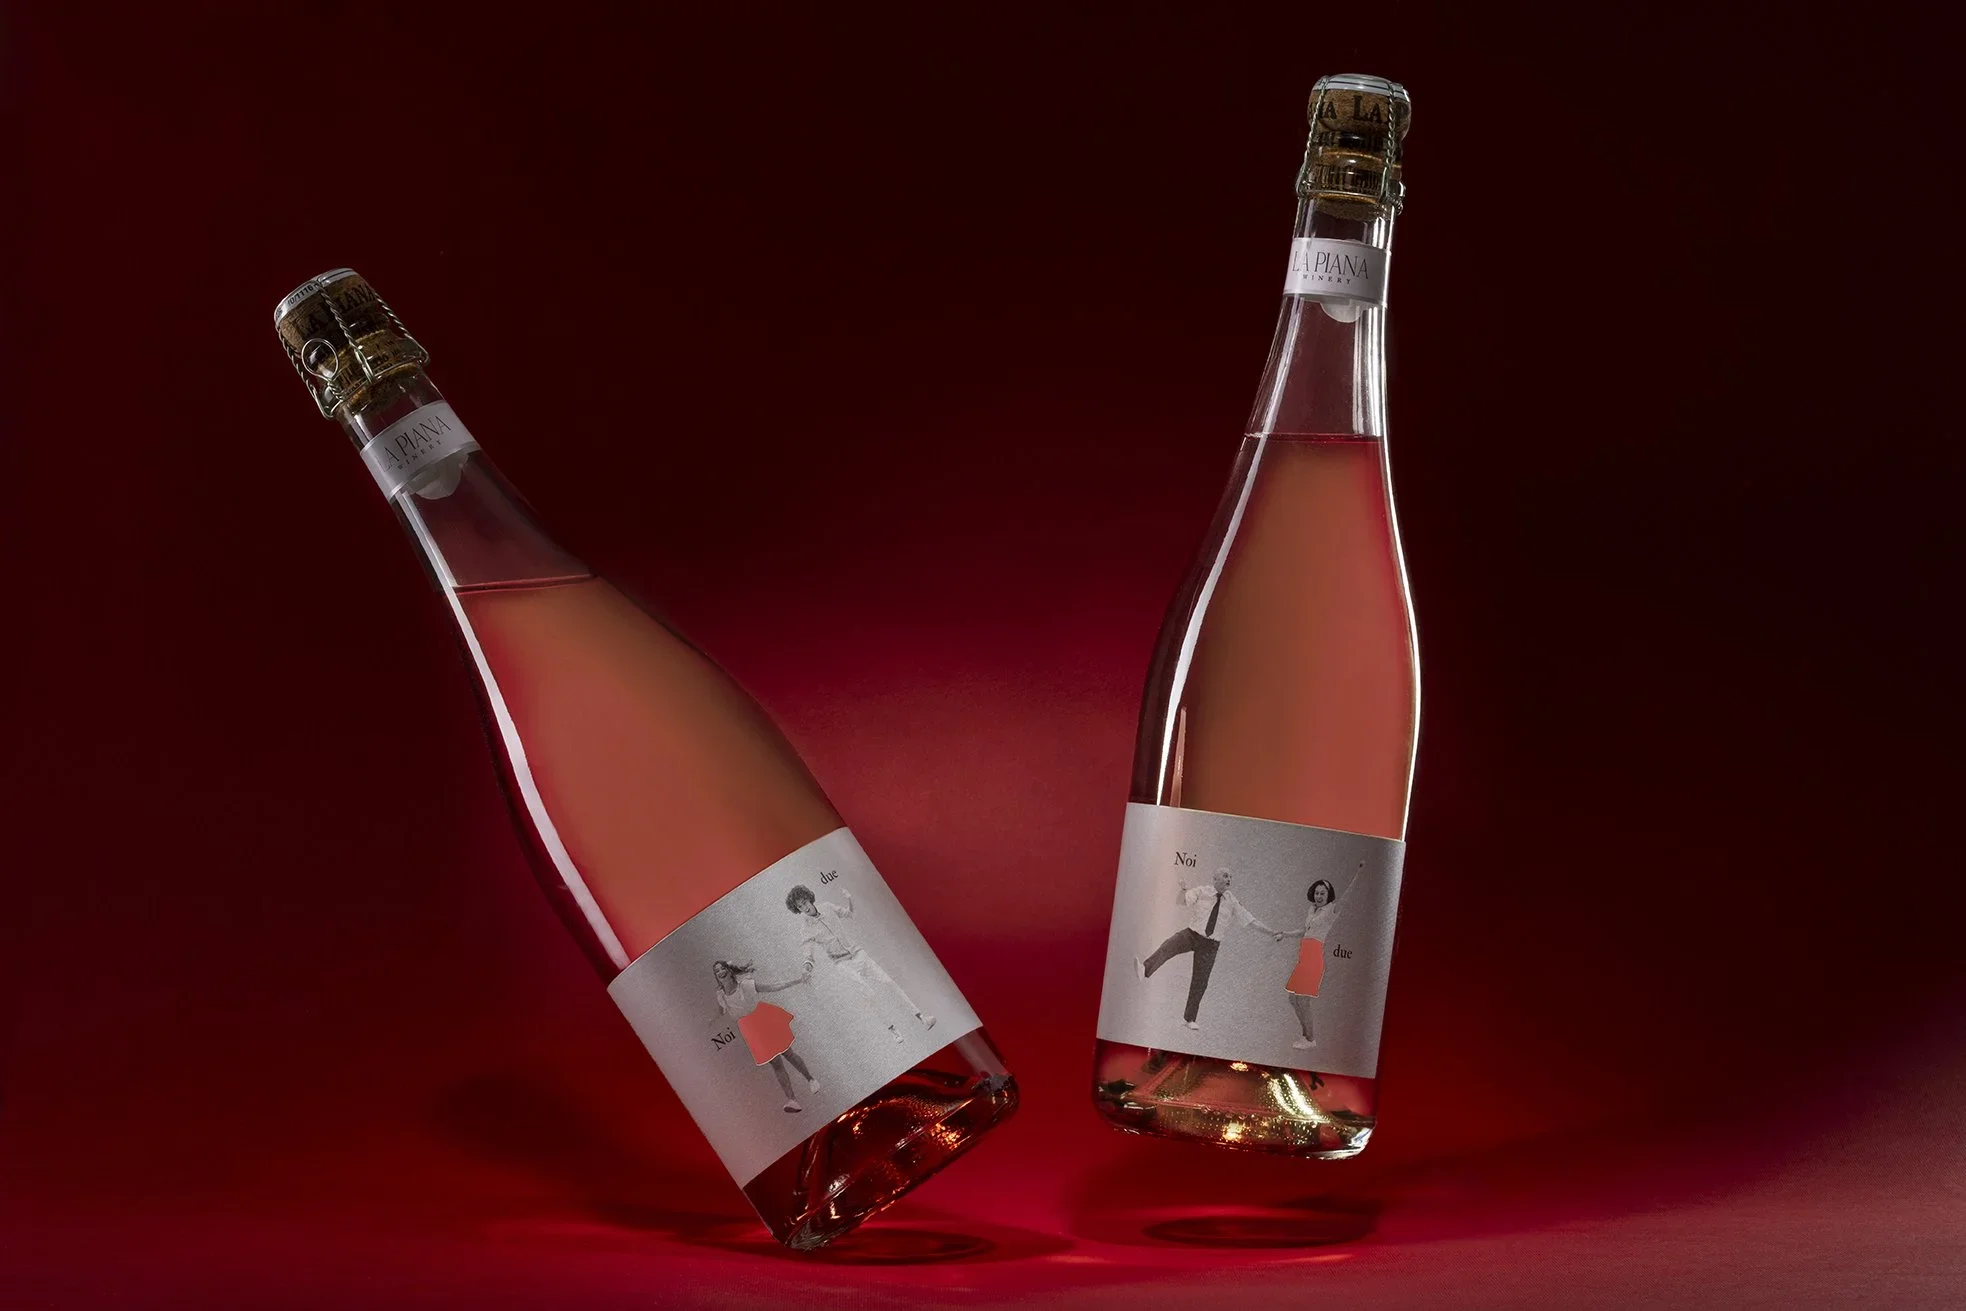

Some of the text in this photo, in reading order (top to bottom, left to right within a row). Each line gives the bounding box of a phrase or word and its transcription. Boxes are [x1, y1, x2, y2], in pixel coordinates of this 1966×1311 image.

[1292, 250, 1369, 280] LA PIANA
[1302, 274, 1352, 285] WINERY
[394, 415, 452, 457] PIANA
[397, 440, 443, 470] WINERY
[1174, 852, 1197, 868] Noi
[820, 868, 839, 885] due
[1333, 944, 1353, 960] due
[711, 1026, 736, 1051] Noi
